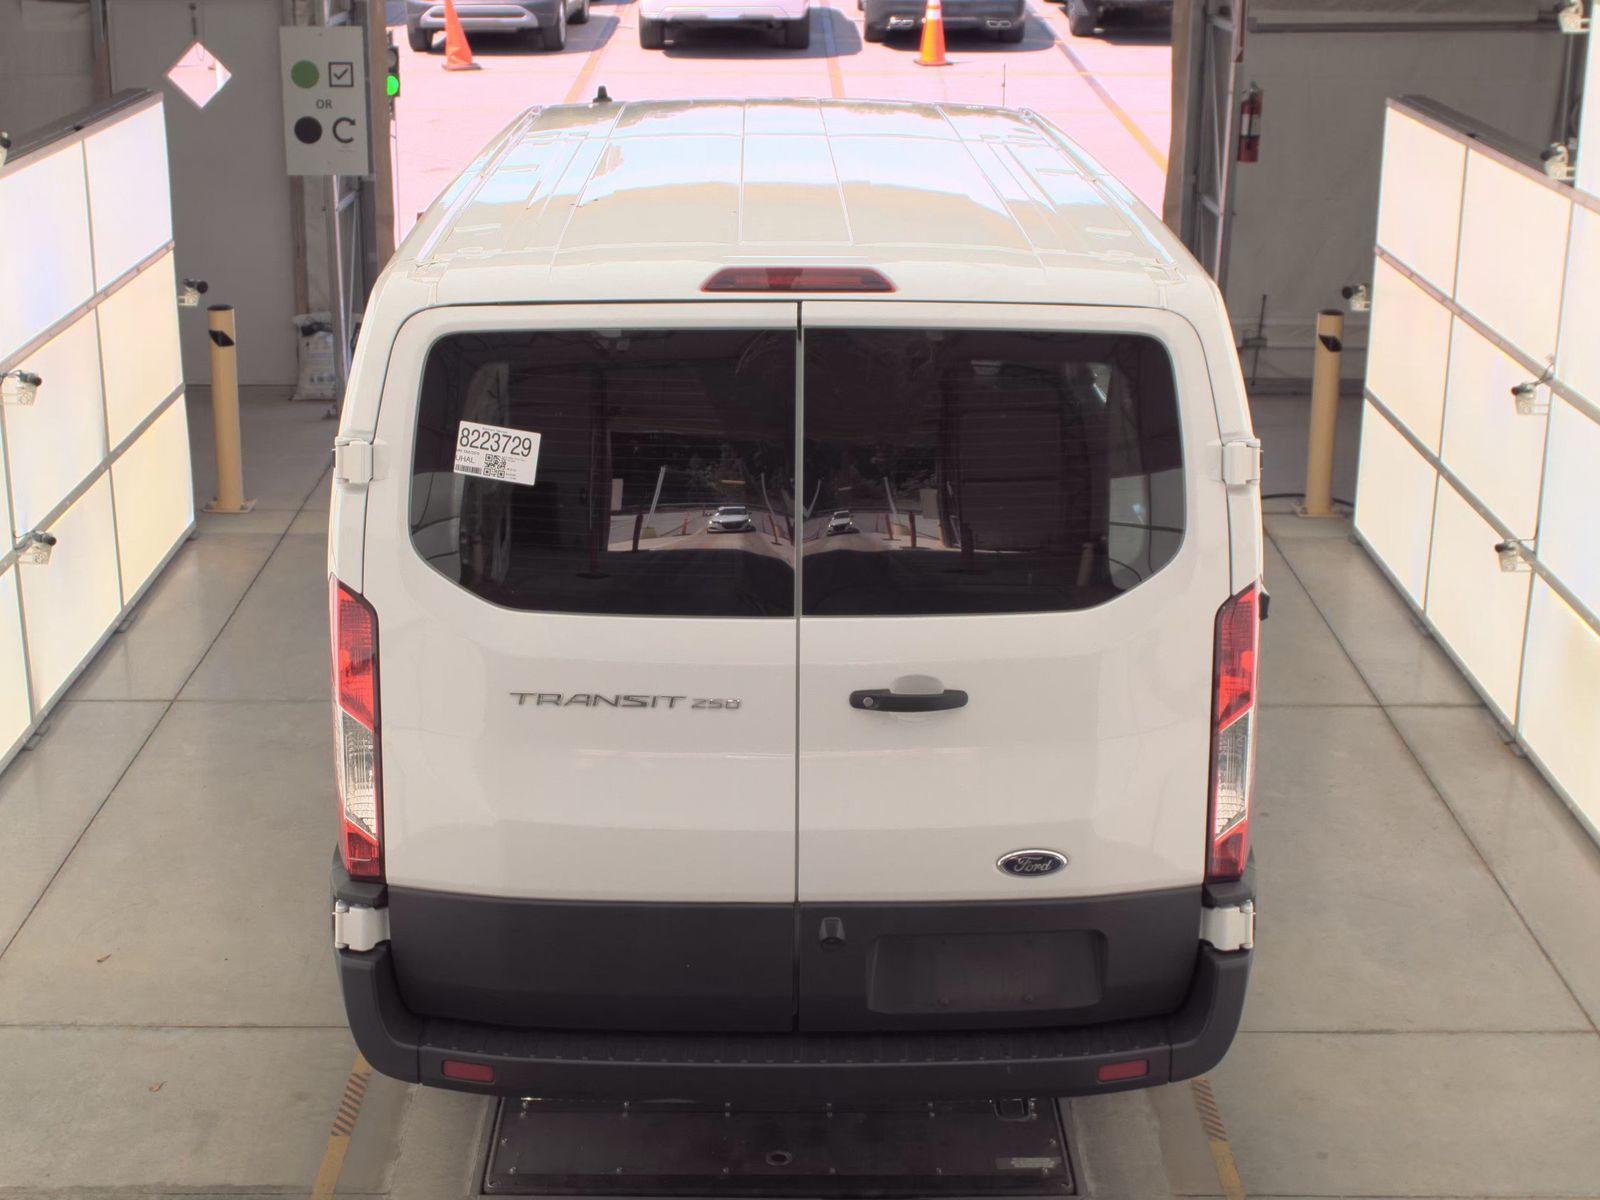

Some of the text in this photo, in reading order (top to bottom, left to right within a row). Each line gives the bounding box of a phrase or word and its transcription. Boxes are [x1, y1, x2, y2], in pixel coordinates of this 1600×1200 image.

[316, 99, 333, 110] OR
[460, 427, 533, 458] 8223729
[510, 692, 741, 709] TRANSIT 250
[1014, 856, 1052, 873] Ford
